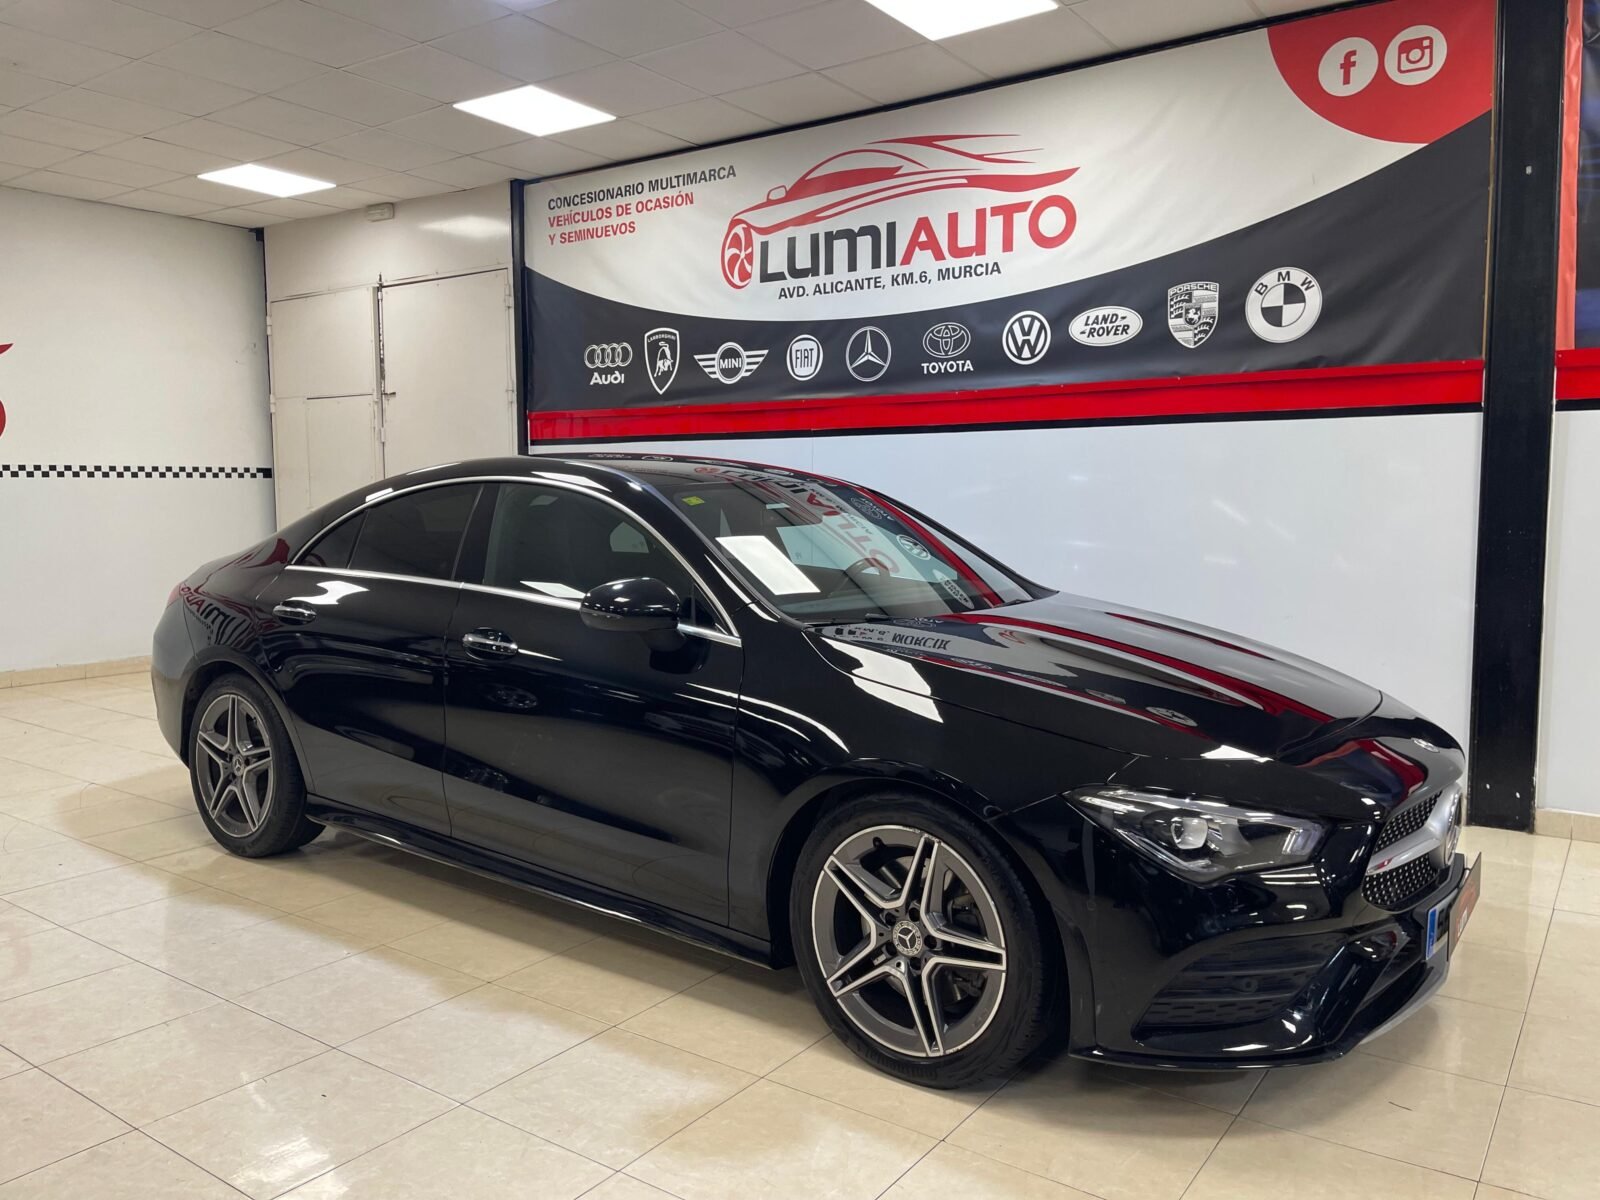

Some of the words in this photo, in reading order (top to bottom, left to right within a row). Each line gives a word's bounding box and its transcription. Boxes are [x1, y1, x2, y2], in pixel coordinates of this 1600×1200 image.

[547, 182, 644, 211] CONCESIONARIO
[648, 165, 736, 193] MULTIMARCA
[548, 207, 613, 228] VEHÍCULOS
[616, 202, 632, 216] DE
[636, 191, 694, 213] OCASIÓN
[549, 234, 556, 246] Y
[558, 221, 636, 244] SEMINUEVOS
[777, 285, 809, 300] AVD.
[813, 276, 886, 296] ALICANTE,
[891, 269, 932, 287] KM.6,
[937, 261, 1001, 281] MURCIA
[1168, 282, 1217, 298] PORSCHE
[1254, 270, 1315, 296] BMW
[719, 357, 742, 370] MINI
[795, 348, 815, 368] FIAT
[921, 360, 974, 375] TOYOTA
[589, 371, 625, 386] Audi
